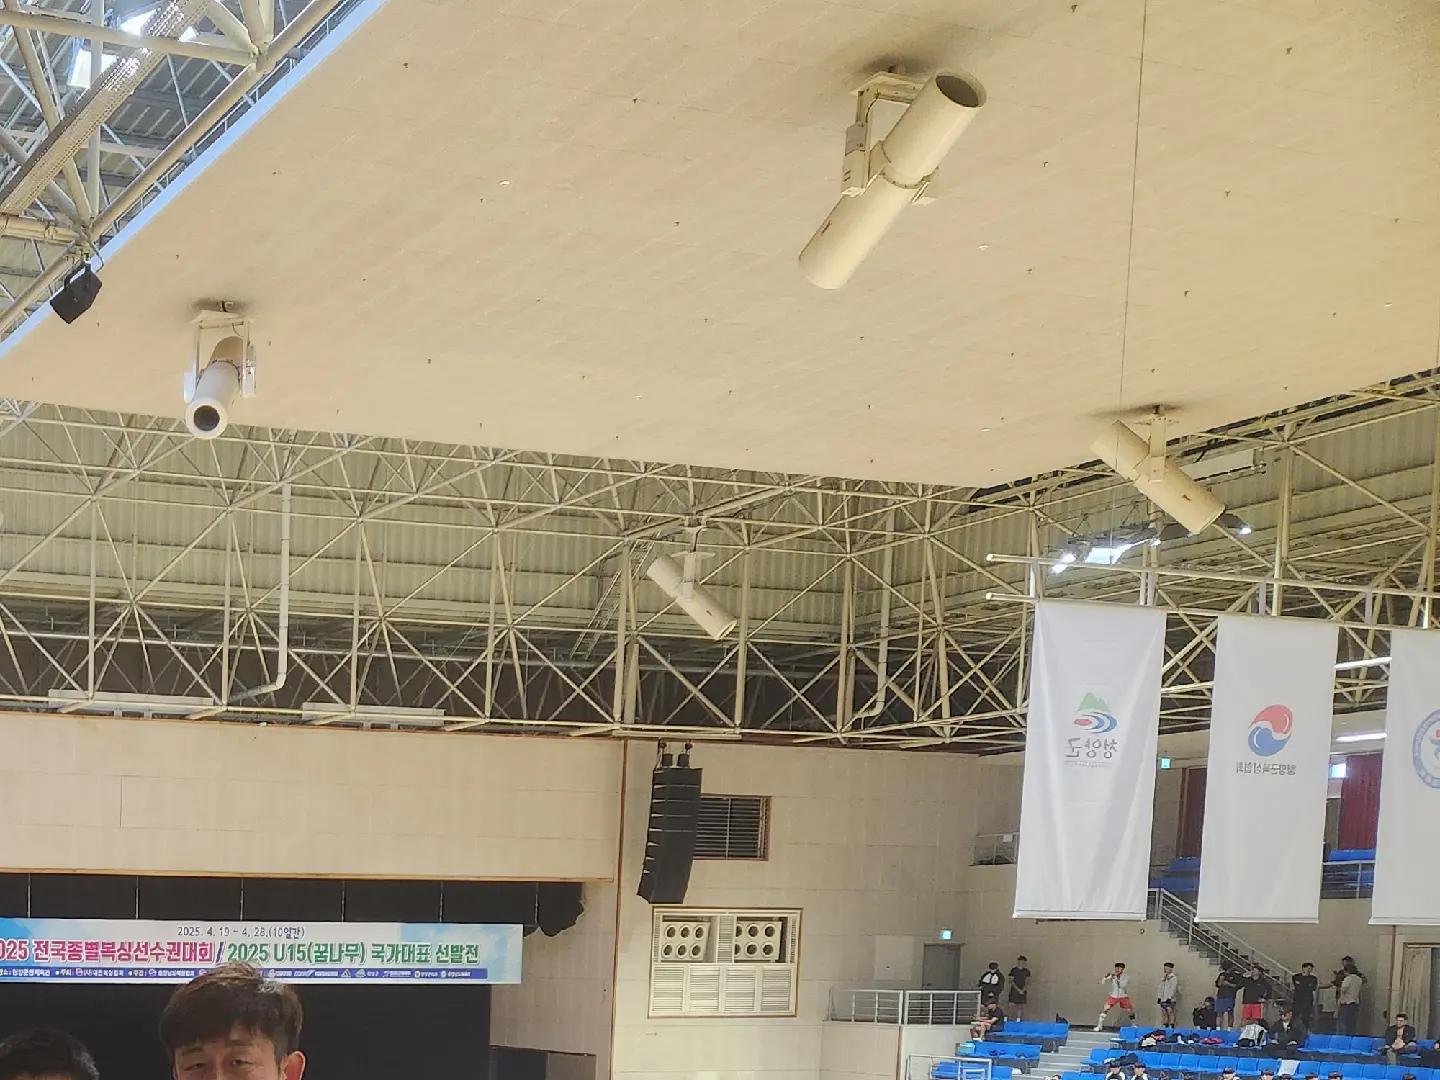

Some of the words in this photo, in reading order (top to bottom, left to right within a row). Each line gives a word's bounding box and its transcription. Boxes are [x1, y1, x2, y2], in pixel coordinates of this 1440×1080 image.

[177, 926, 203, 937] 2025.
[219, 927, 230, 937] 19
[33, 939, 215, 963] 전국종별복싱선수권대회
[227, 942, 270, 963] 2025
[273, 942, 366, 964] U15(꿈나무)
[371, 943, 431, 964] 국가대표
[435, 943, 480, 965] 선발전
